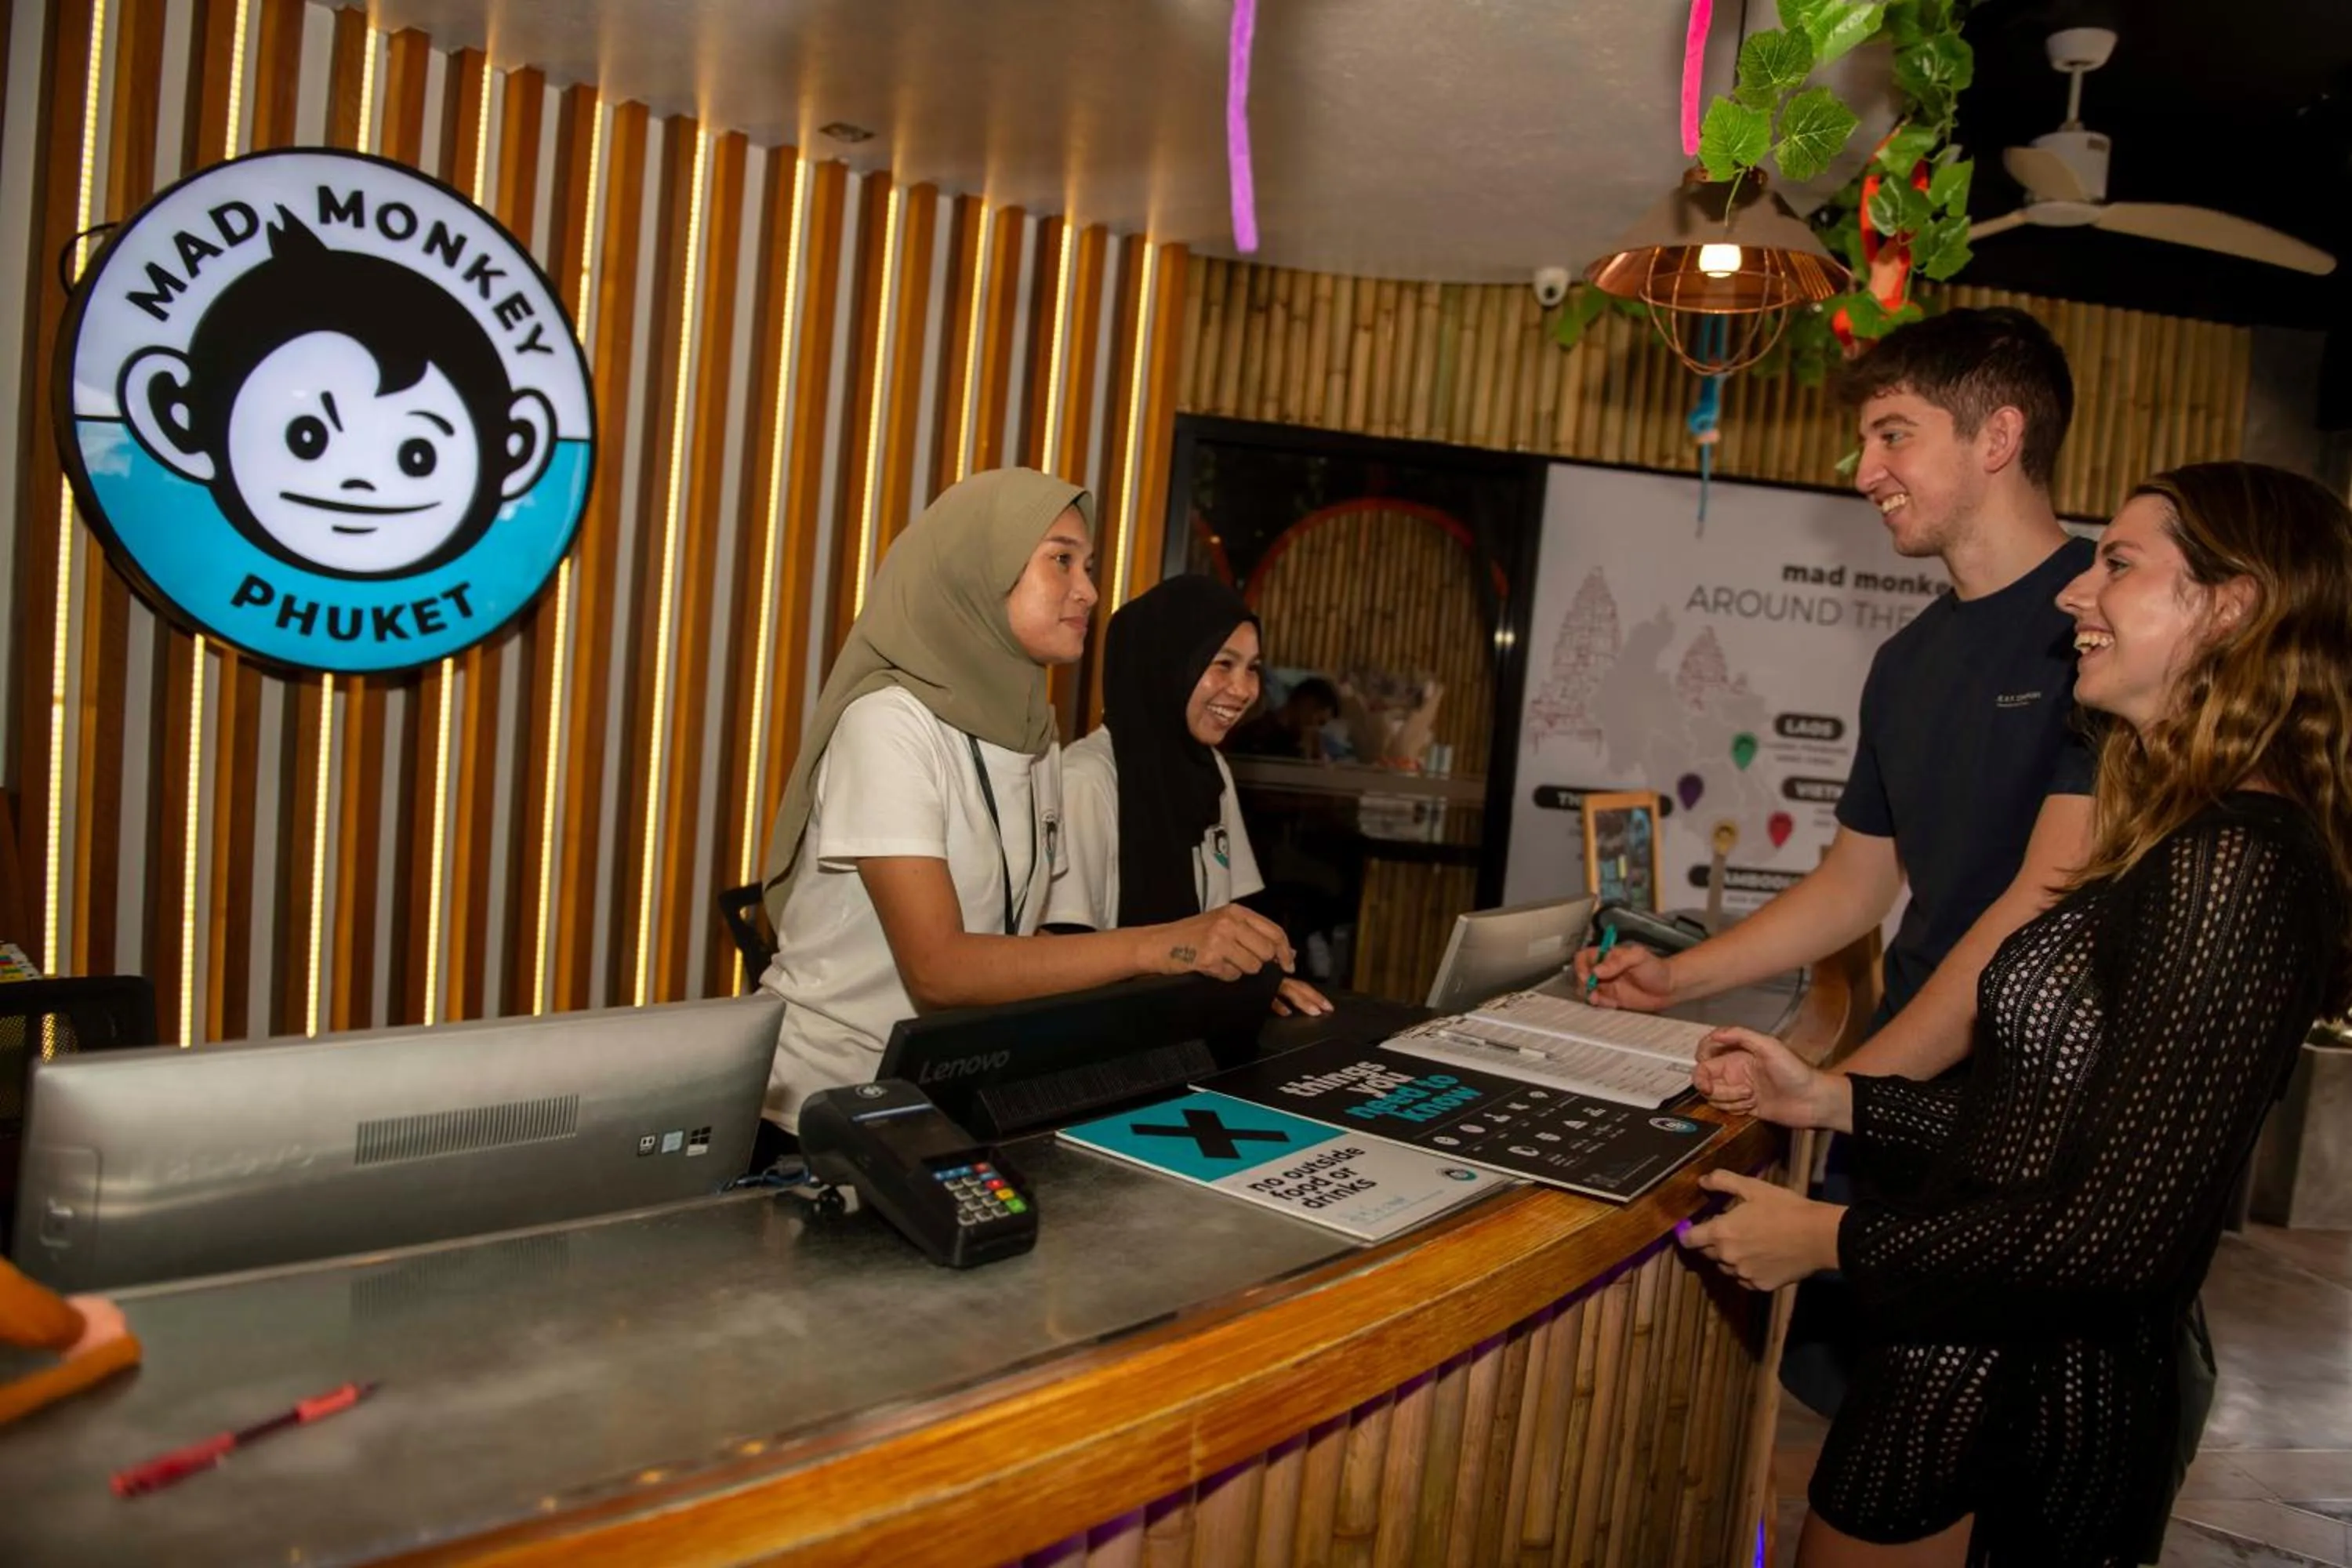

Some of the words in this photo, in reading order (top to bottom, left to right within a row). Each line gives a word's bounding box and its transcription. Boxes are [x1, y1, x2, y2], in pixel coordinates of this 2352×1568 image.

[125, 201, 260, 322] MAD
[317, 185, 556, 358] MONKEY
[1782, 564, 1846, 587] mad
[1853, 572, 1951, 596] monke
[230, 574, 475, 642] PHUKET
[1685, 585, 1844, 627] AROUND
[918, 1050, 1011, 1085] Lenovo
[1278, 1061, 1386, 1097] things
[1346, 1071, 1415, 1098] you
[1345, 1084, 1432, 1120] need
[1412, 1074, 1459, 1089] to
[1388, 1086, 1483, 1122] know
[1247, 1177, 1280, 1192] no
[1283, 1146, 1367, 1179] outside
[1269, 1175, 1326, 1201] food
[1329, 1167, 1359, 1181] or
[1302, 1178, 1377, 1209] drinks
